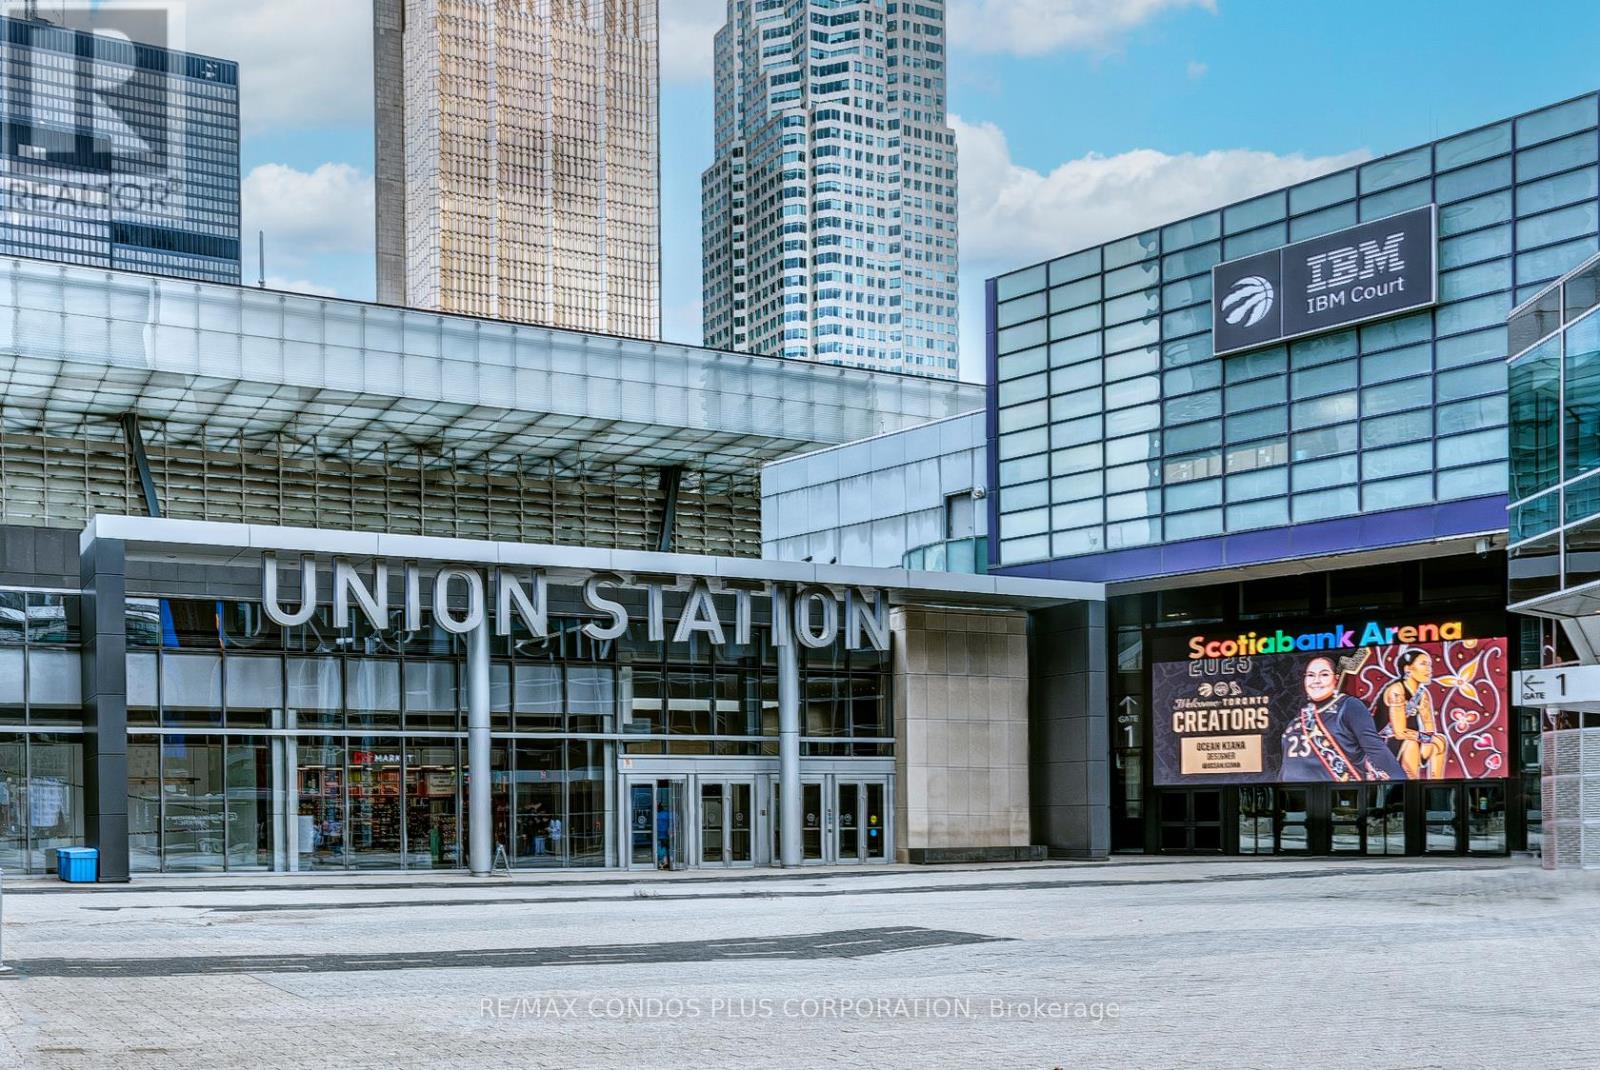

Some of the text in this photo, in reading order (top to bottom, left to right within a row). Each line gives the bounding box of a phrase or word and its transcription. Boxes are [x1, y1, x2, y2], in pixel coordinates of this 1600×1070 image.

[1307, 232, 1405, 293] IBM
[1307, 276, 1405, 314] IBM Court
[262, 550, 892, 651] UNION STATION
[1188, 621, 1463, 659] Scotiabank Arena
[1555, 673, 1567, 696] 1
[1222, 696, 1269, 706] TORONTO
[1173, 707, 1269, 733] CREATORS
[1124, 725, 1133, 748] 1
[1196, 742, 1220, 751] OCEAN
[1288, 735, 1312, 757] 23
[374, 754, 414, 763] MARKT
[1207, 752, 1236, 760] DESIGNER
